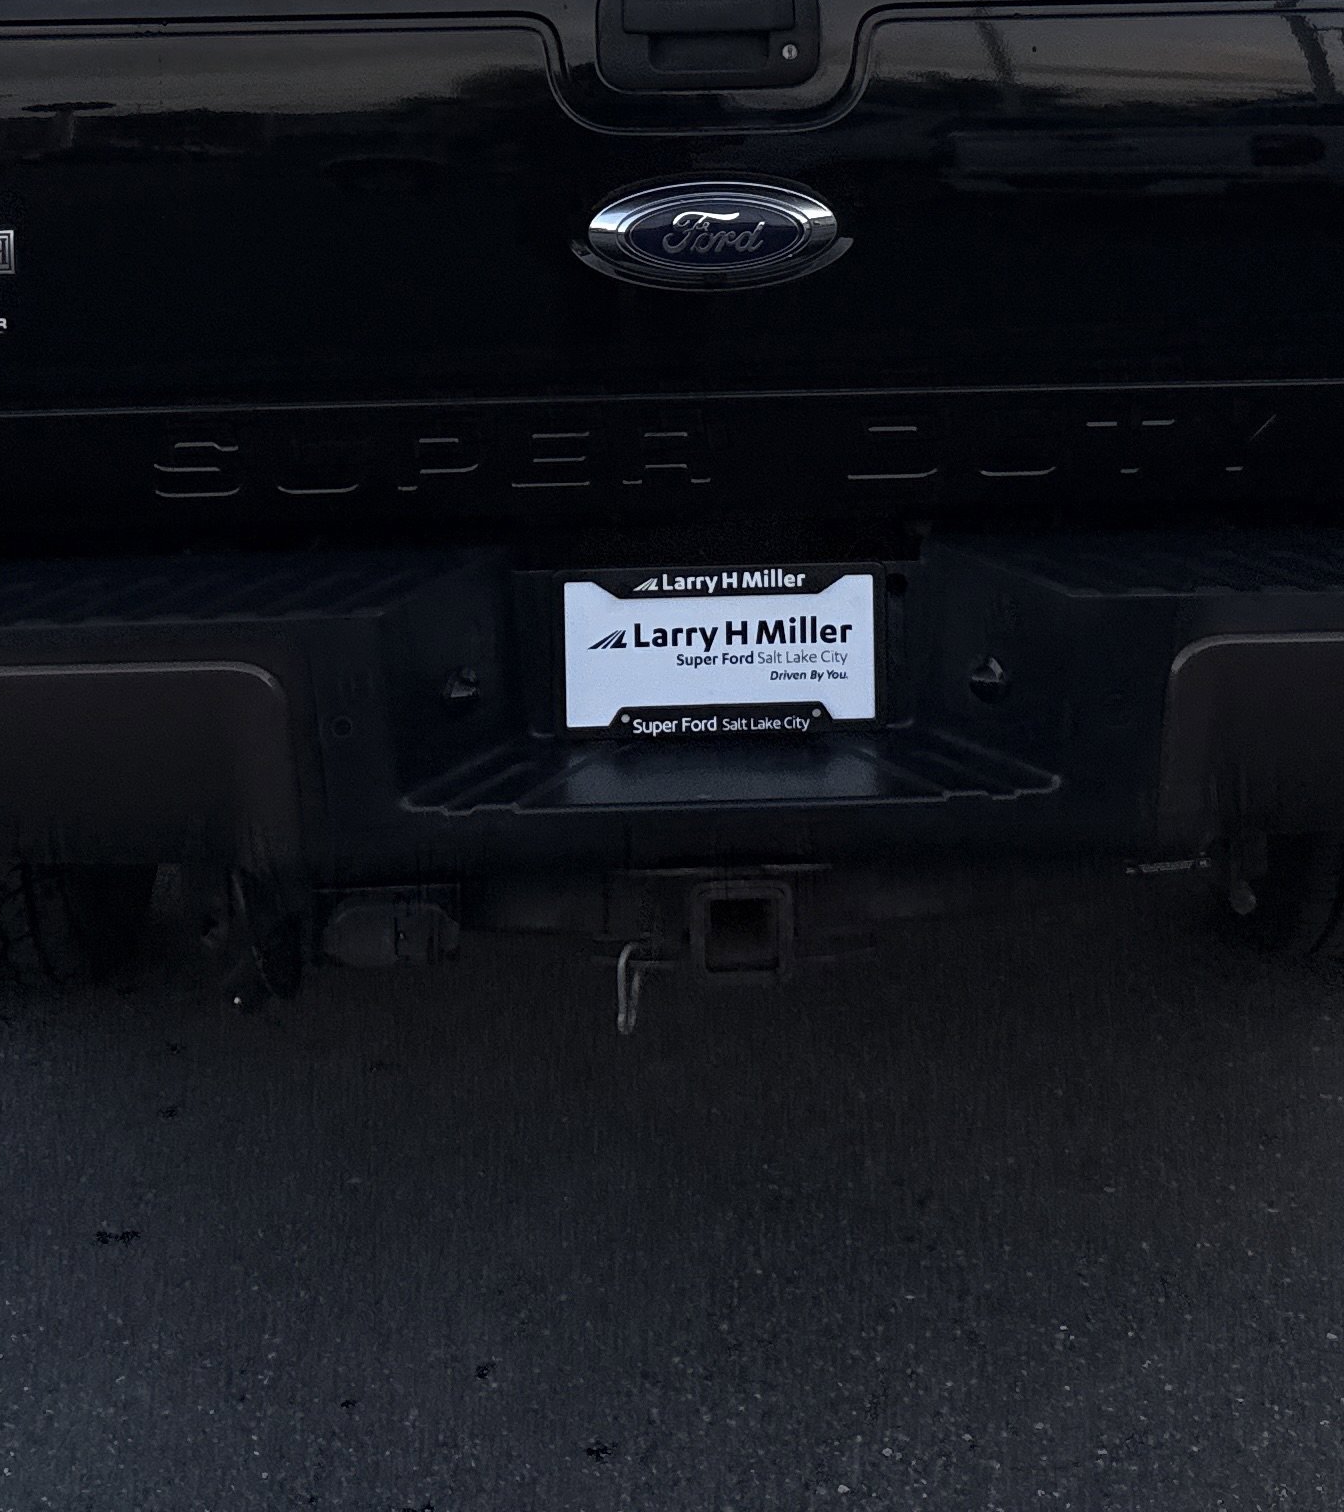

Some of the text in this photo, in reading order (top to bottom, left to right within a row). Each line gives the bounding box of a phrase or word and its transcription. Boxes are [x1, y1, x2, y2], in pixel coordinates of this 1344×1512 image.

[662, 211, 765, 254] Ford
[662, 569, 805, 593] Larry H Miller
[633, 616, 852, 652] Larry H Miller
[676, 649, 848, 669] Super Ford Salt Lake City
[770, 670, 807, 681] Driven
[810, 670, 824, 682] By
[632, 715, 811, 736] Super Ford Salt Lake City
